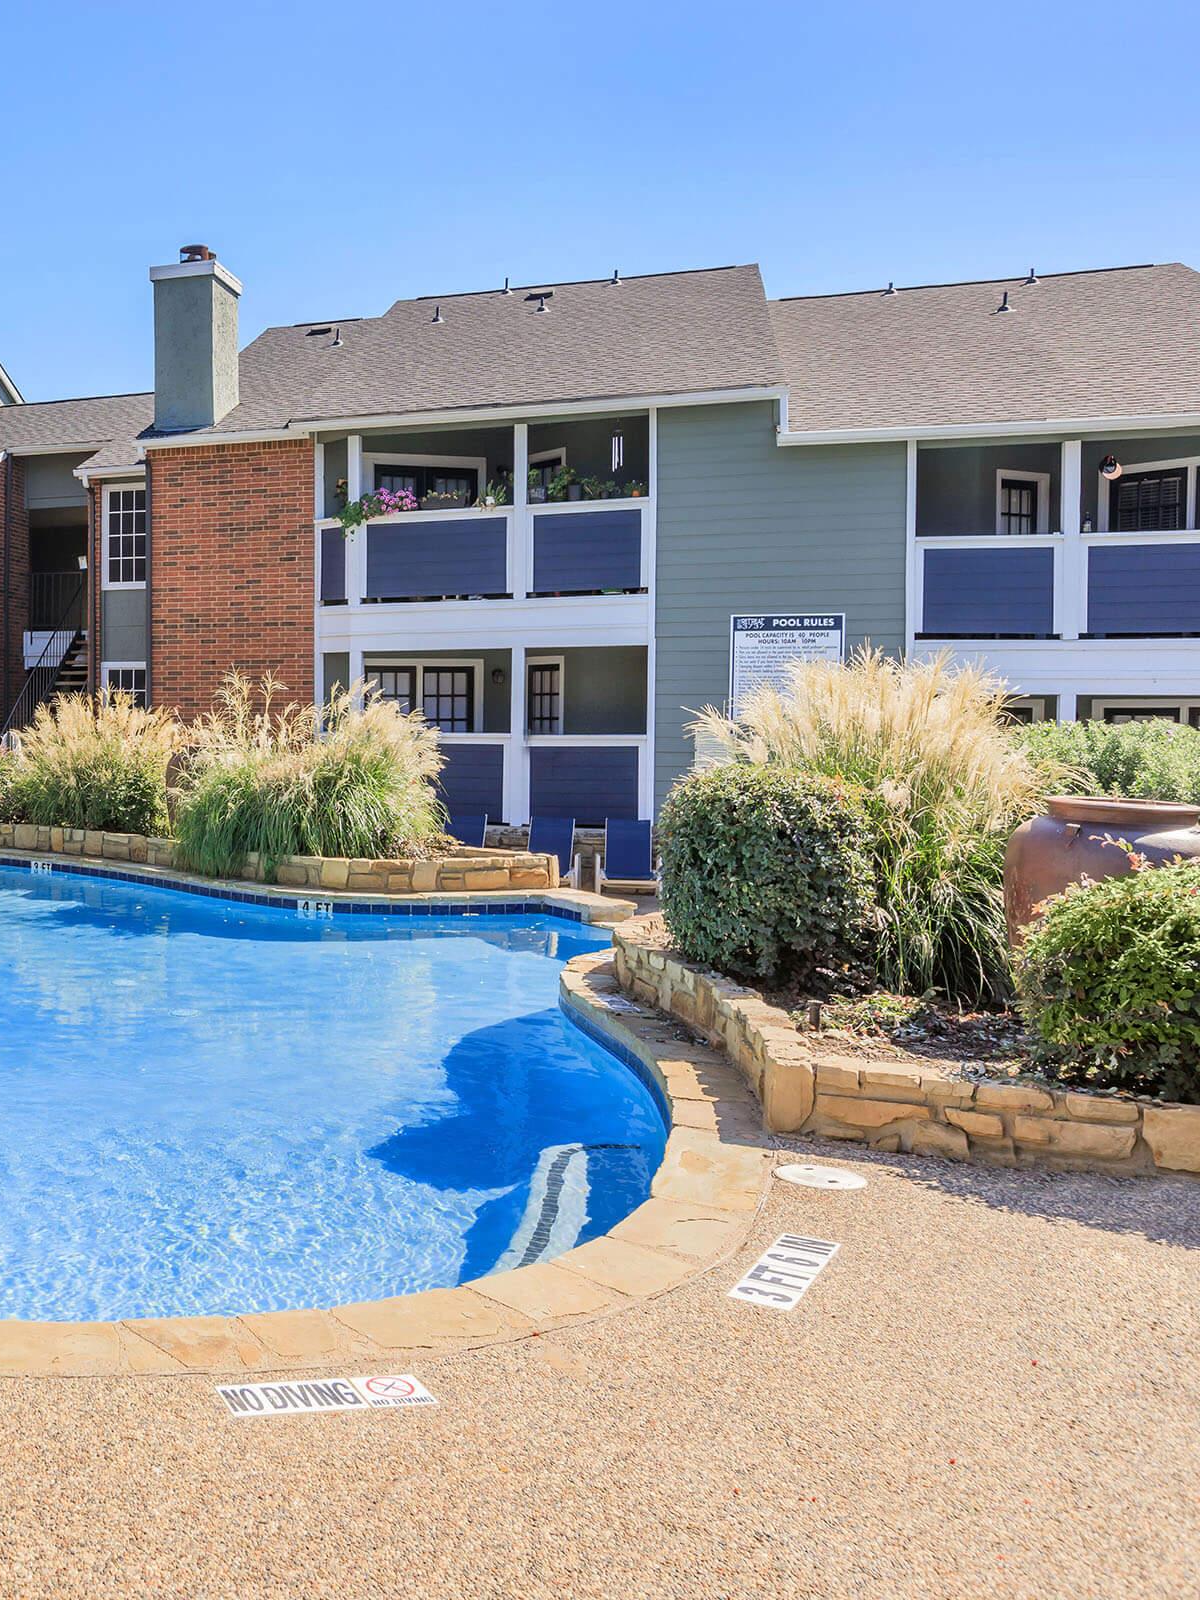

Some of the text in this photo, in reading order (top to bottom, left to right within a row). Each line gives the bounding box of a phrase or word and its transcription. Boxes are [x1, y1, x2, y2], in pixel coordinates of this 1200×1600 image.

[772, 618, 835, 627] POOL RULES
[316, 902, 331, 912] FT
[737, 1234, 836, 1302] 3 FT 6 IN
[220, 1382, 362, 1412] NO DIVING
[393, 1396, 434, 1405] DIVING
